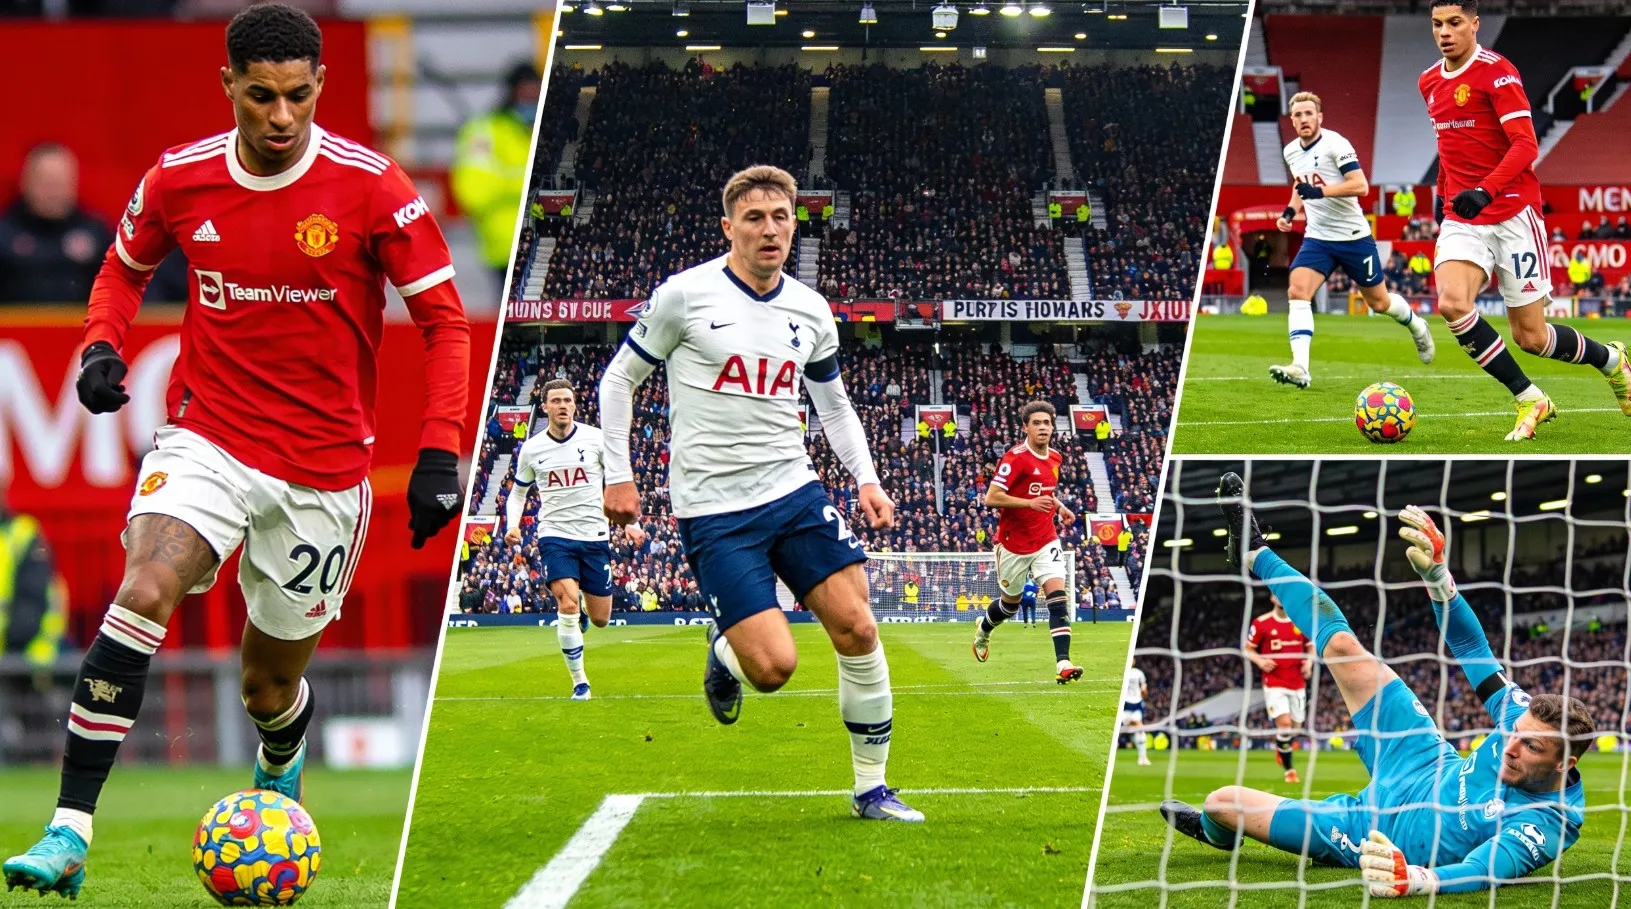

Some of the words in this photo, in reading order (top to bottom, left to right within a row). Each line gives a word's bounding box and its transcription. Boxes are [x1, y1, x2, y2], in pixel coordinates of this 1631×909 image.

[1362, 255, 1373, 276] 7
[1511, 252, 1538, 279] 12
[224, 282, 338, 303] TeamViewer
[1000, 301, 1018, 318] IS
[712, 355, 796, 396] AIA
[547, 467, 589, 487] AIA
[1050, 547, 1063, 562] 2
[281, 543, 346, 595] 20
